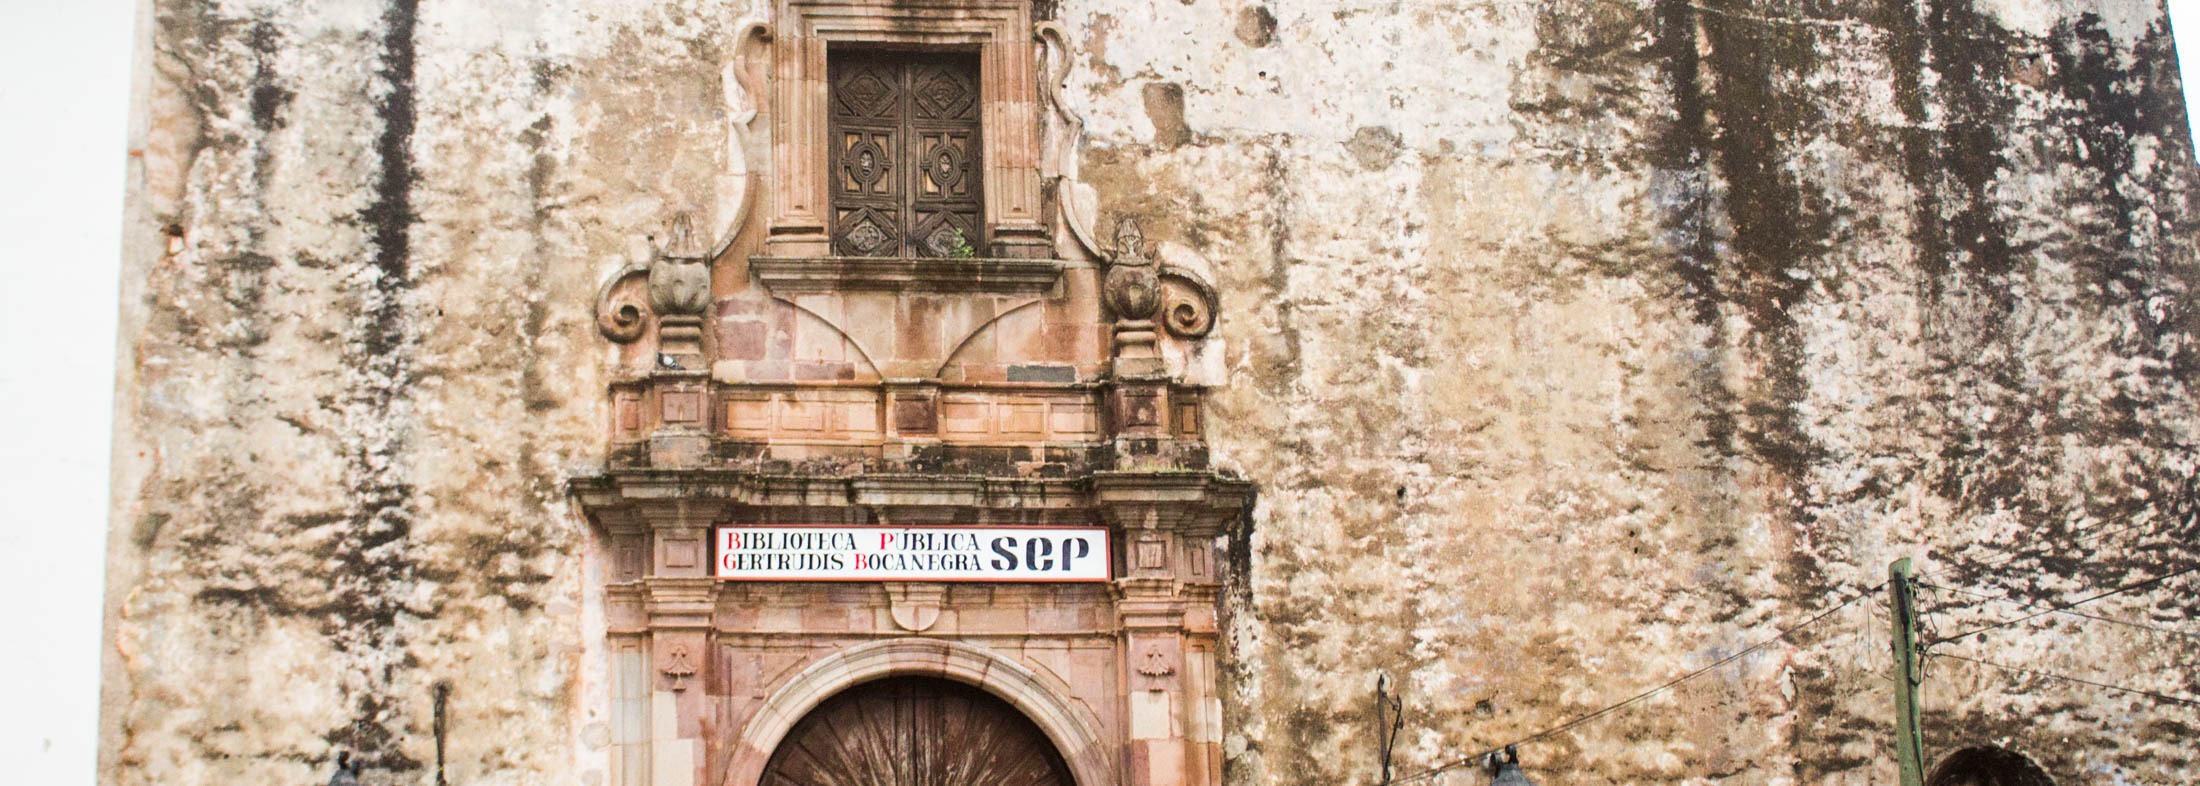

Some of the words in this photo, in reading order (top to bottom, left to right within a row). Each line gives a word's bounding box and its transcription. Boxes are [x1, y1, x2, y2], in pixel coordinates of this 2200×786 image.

[727, 532, 856, 551] BIBLIOTECA
[879, 529, 981, 551] PÚBLICA
[723, 553, 844, 571] GERTRUDIS
[854, 553, 982, 571] BOCANEGRA
